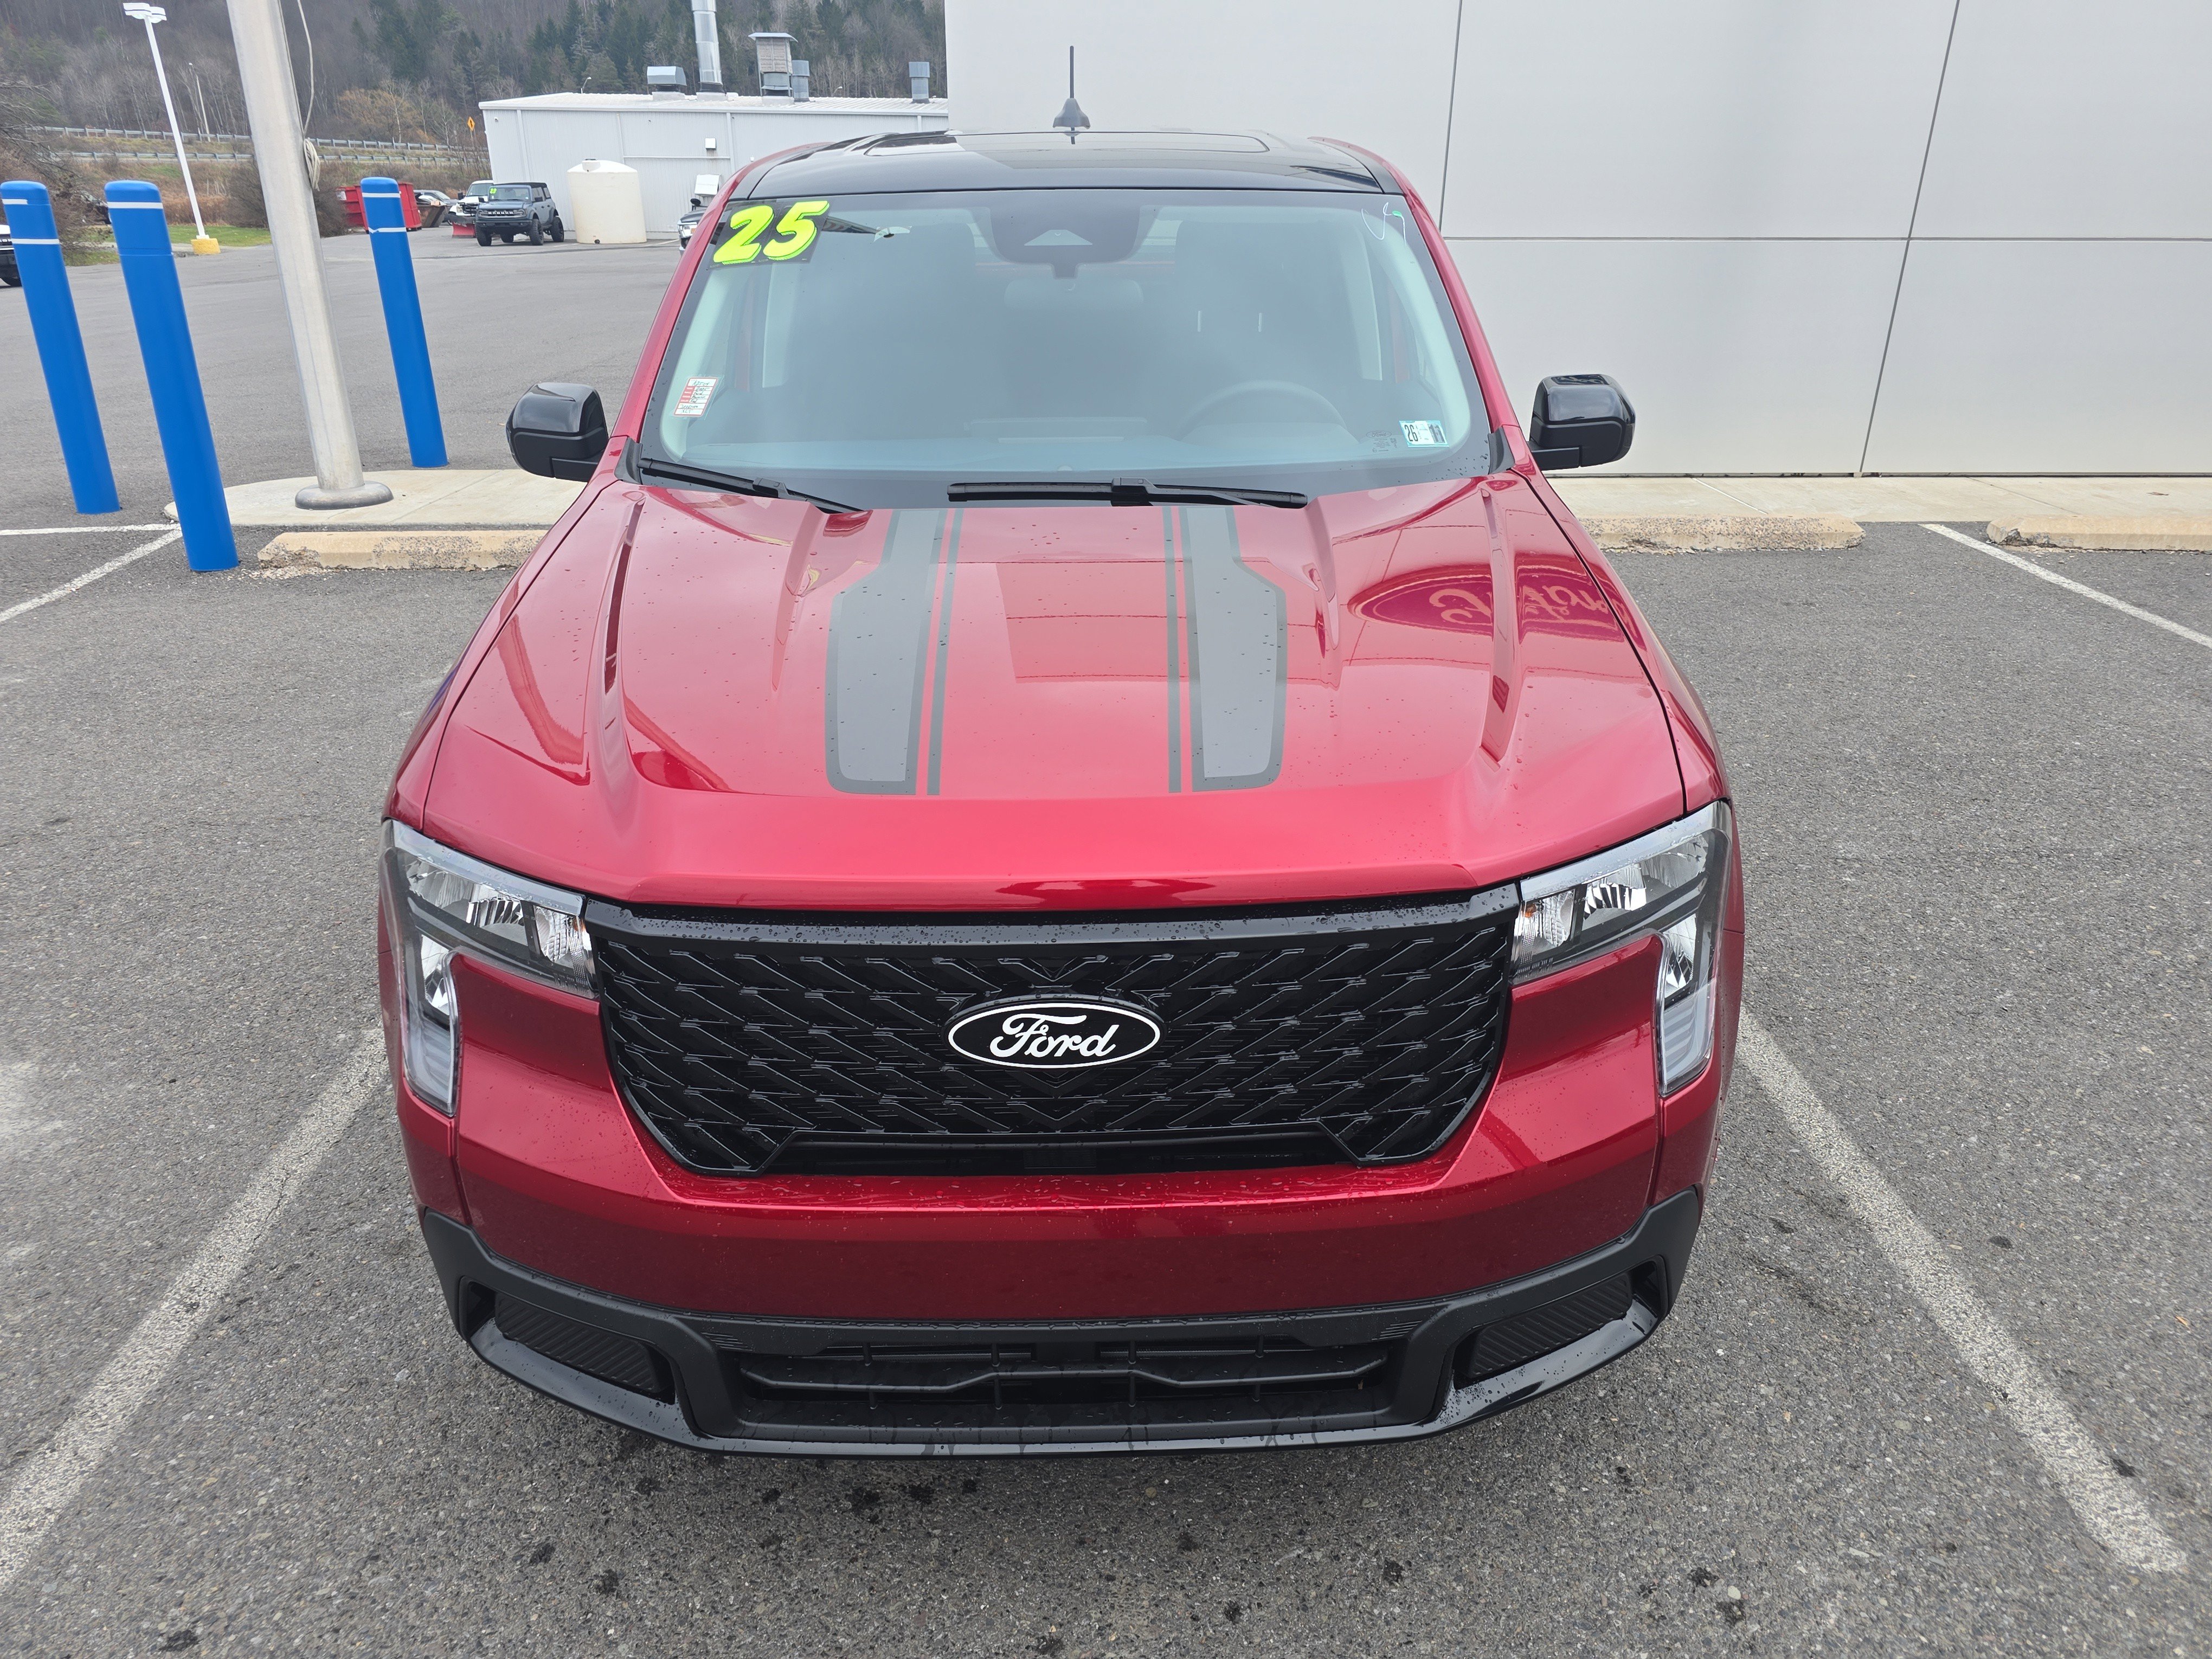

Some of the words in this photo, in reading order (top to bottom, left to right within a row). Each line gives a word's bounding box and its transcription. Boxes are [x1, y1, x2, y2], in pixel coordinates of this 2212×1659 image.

[713, 200, 830, 265] 25
[1404, 424, 1419, 442] 26
[989, 1013, 1120, 1058] Ford
